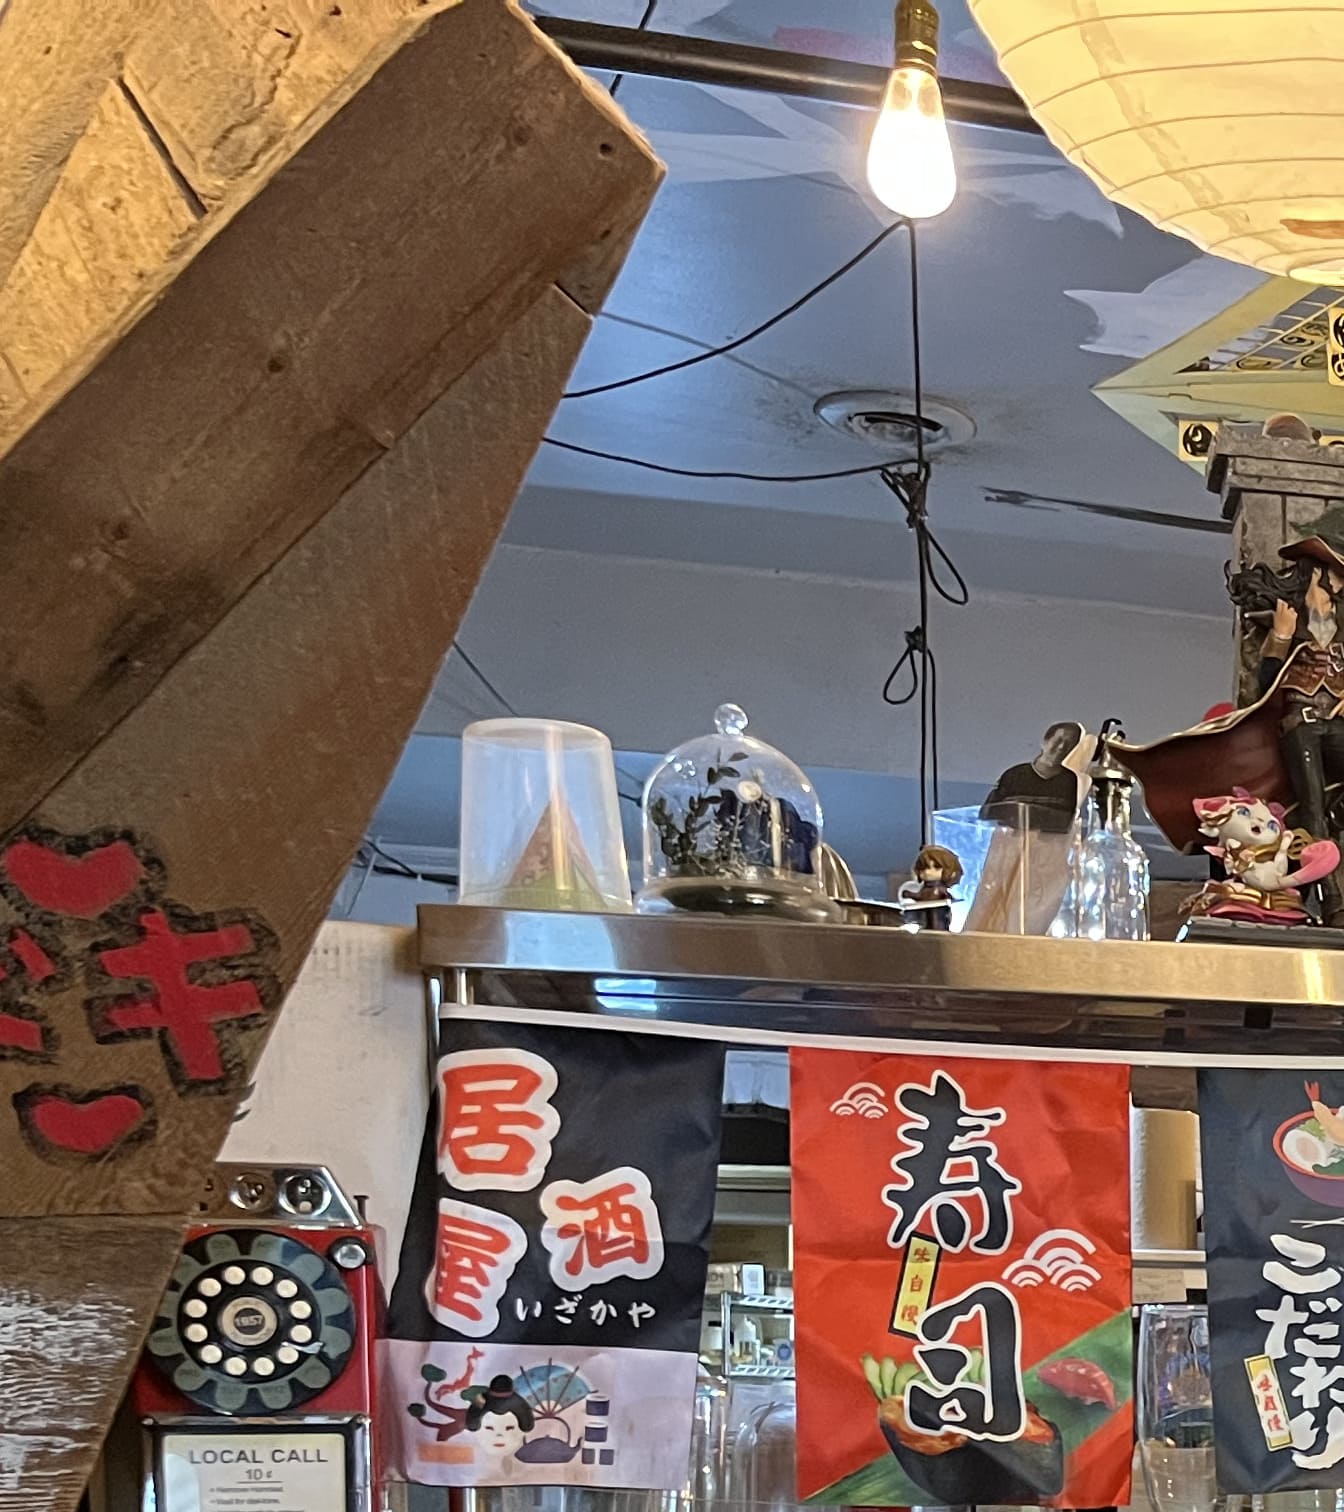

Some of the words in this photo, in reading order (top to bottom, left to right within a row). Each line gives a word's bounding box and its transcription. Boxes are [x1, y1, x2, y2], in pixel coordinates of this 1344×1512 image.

[883, 1069, 1024, 1443] 寿司
[514, 1296, 656, 1328] いざかや
[189, 1450, 264, 1464] LOCAL
[271, 1449, 328, 1463] CALL
